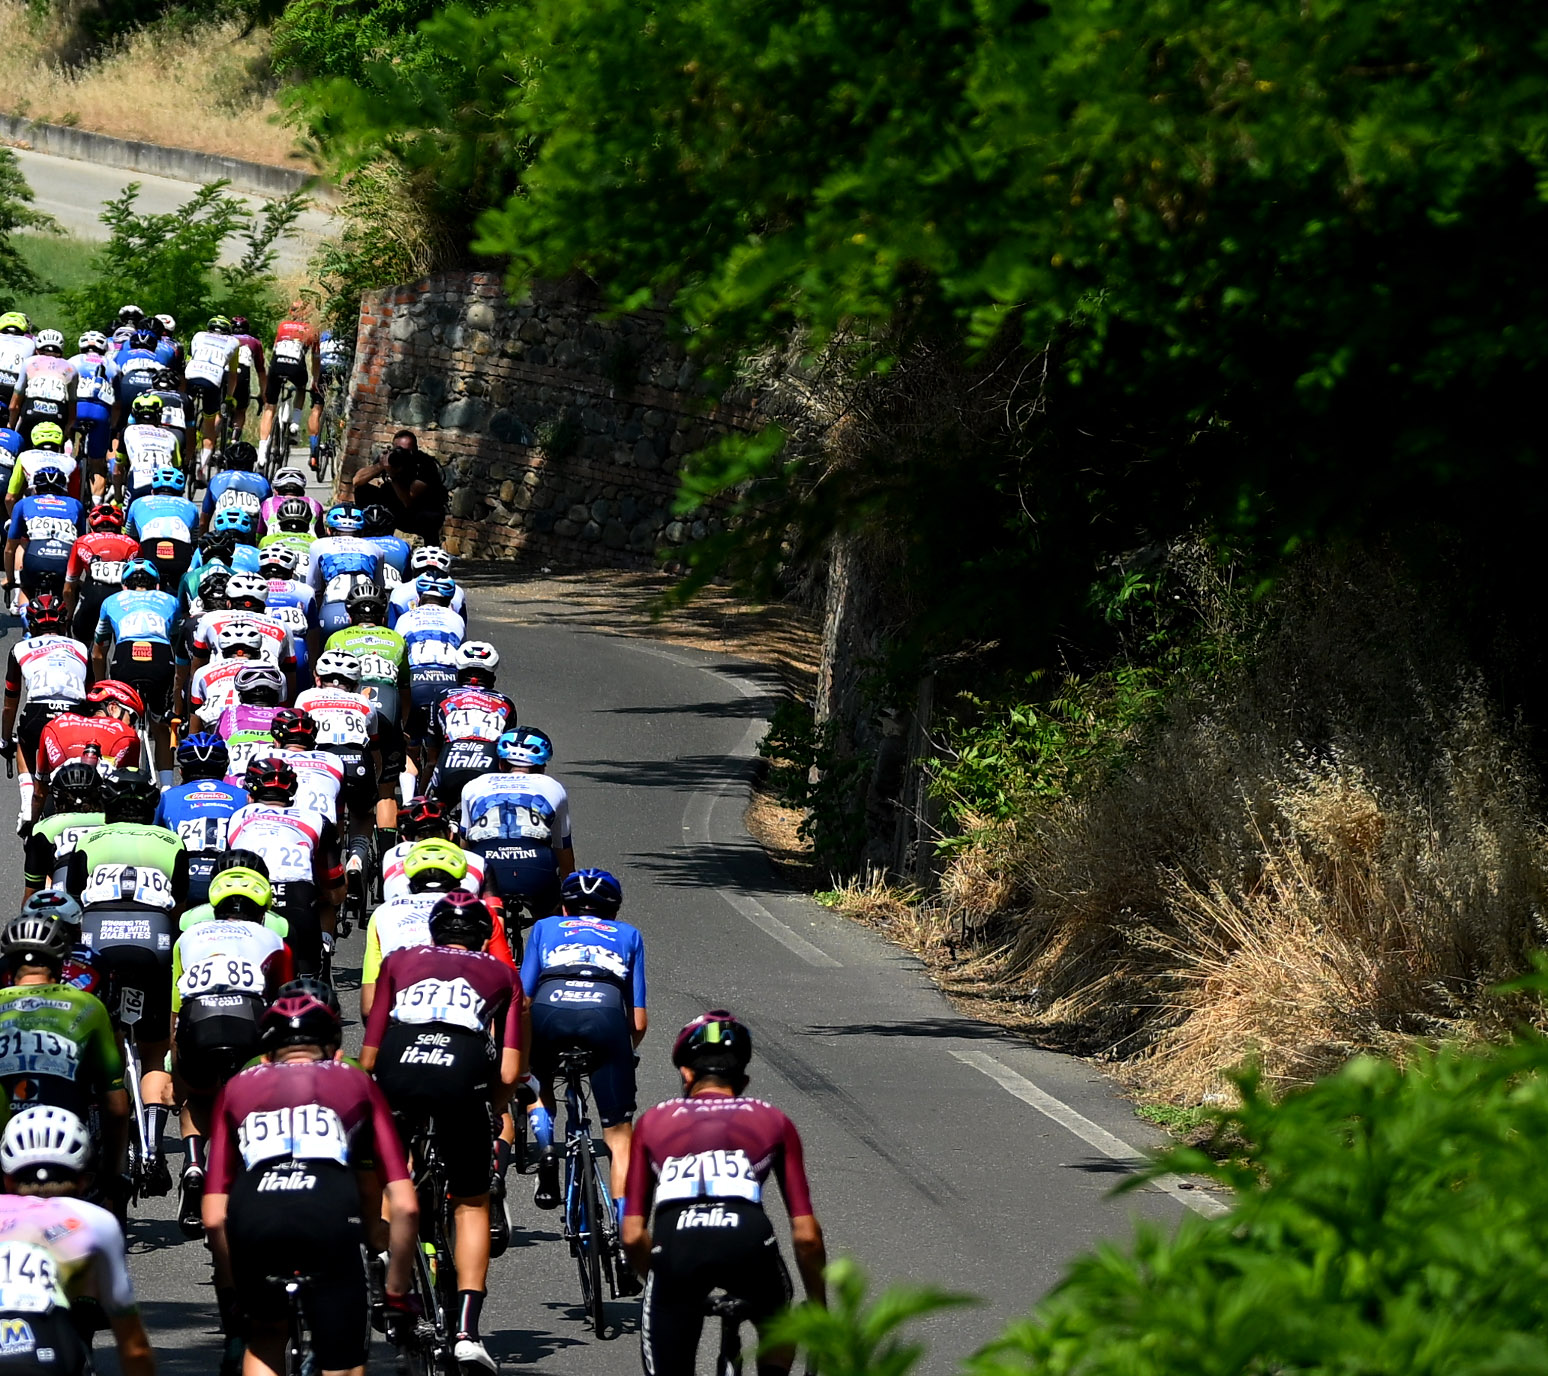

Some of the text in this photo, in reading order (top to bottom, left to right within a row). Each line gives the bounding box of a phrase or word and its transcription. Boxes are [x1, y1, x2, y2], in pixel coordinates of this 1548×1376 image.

[332, 576, 342, 591] 2
[32, 670, 82, 692] 21 21
[412, 672, 456, 682] FANTINI
[48, 701, 70, 711] UAE
[54, 713, 124, 733] ARKEA
[344, 714, 365, 734] 96
[451, 710, 500, 731] 41 41
[451, 741, 485, 752] selle
[445, 751, 492, 769] italia
[308, 790, 329, 814] 23
[241, 807, 301, 819] UAE
[478, 810, 541, 828] 6 6
[279, 846, 305, 869] 22
[484, 849, 538, 860] FANTINI
[99, 933, 152, 941] DIABETES
[100, 926, 151, 934] RACE WITH
[186, 960, 255, 989] 85 85
[402, 984, 440, 1007] 157
[414, 1032, 451, 1047] selle
[399, 1046, 455, 1067] italia
[257, 1171, 317, 1193] italia
[676, 1207, 739, 1231] italia
